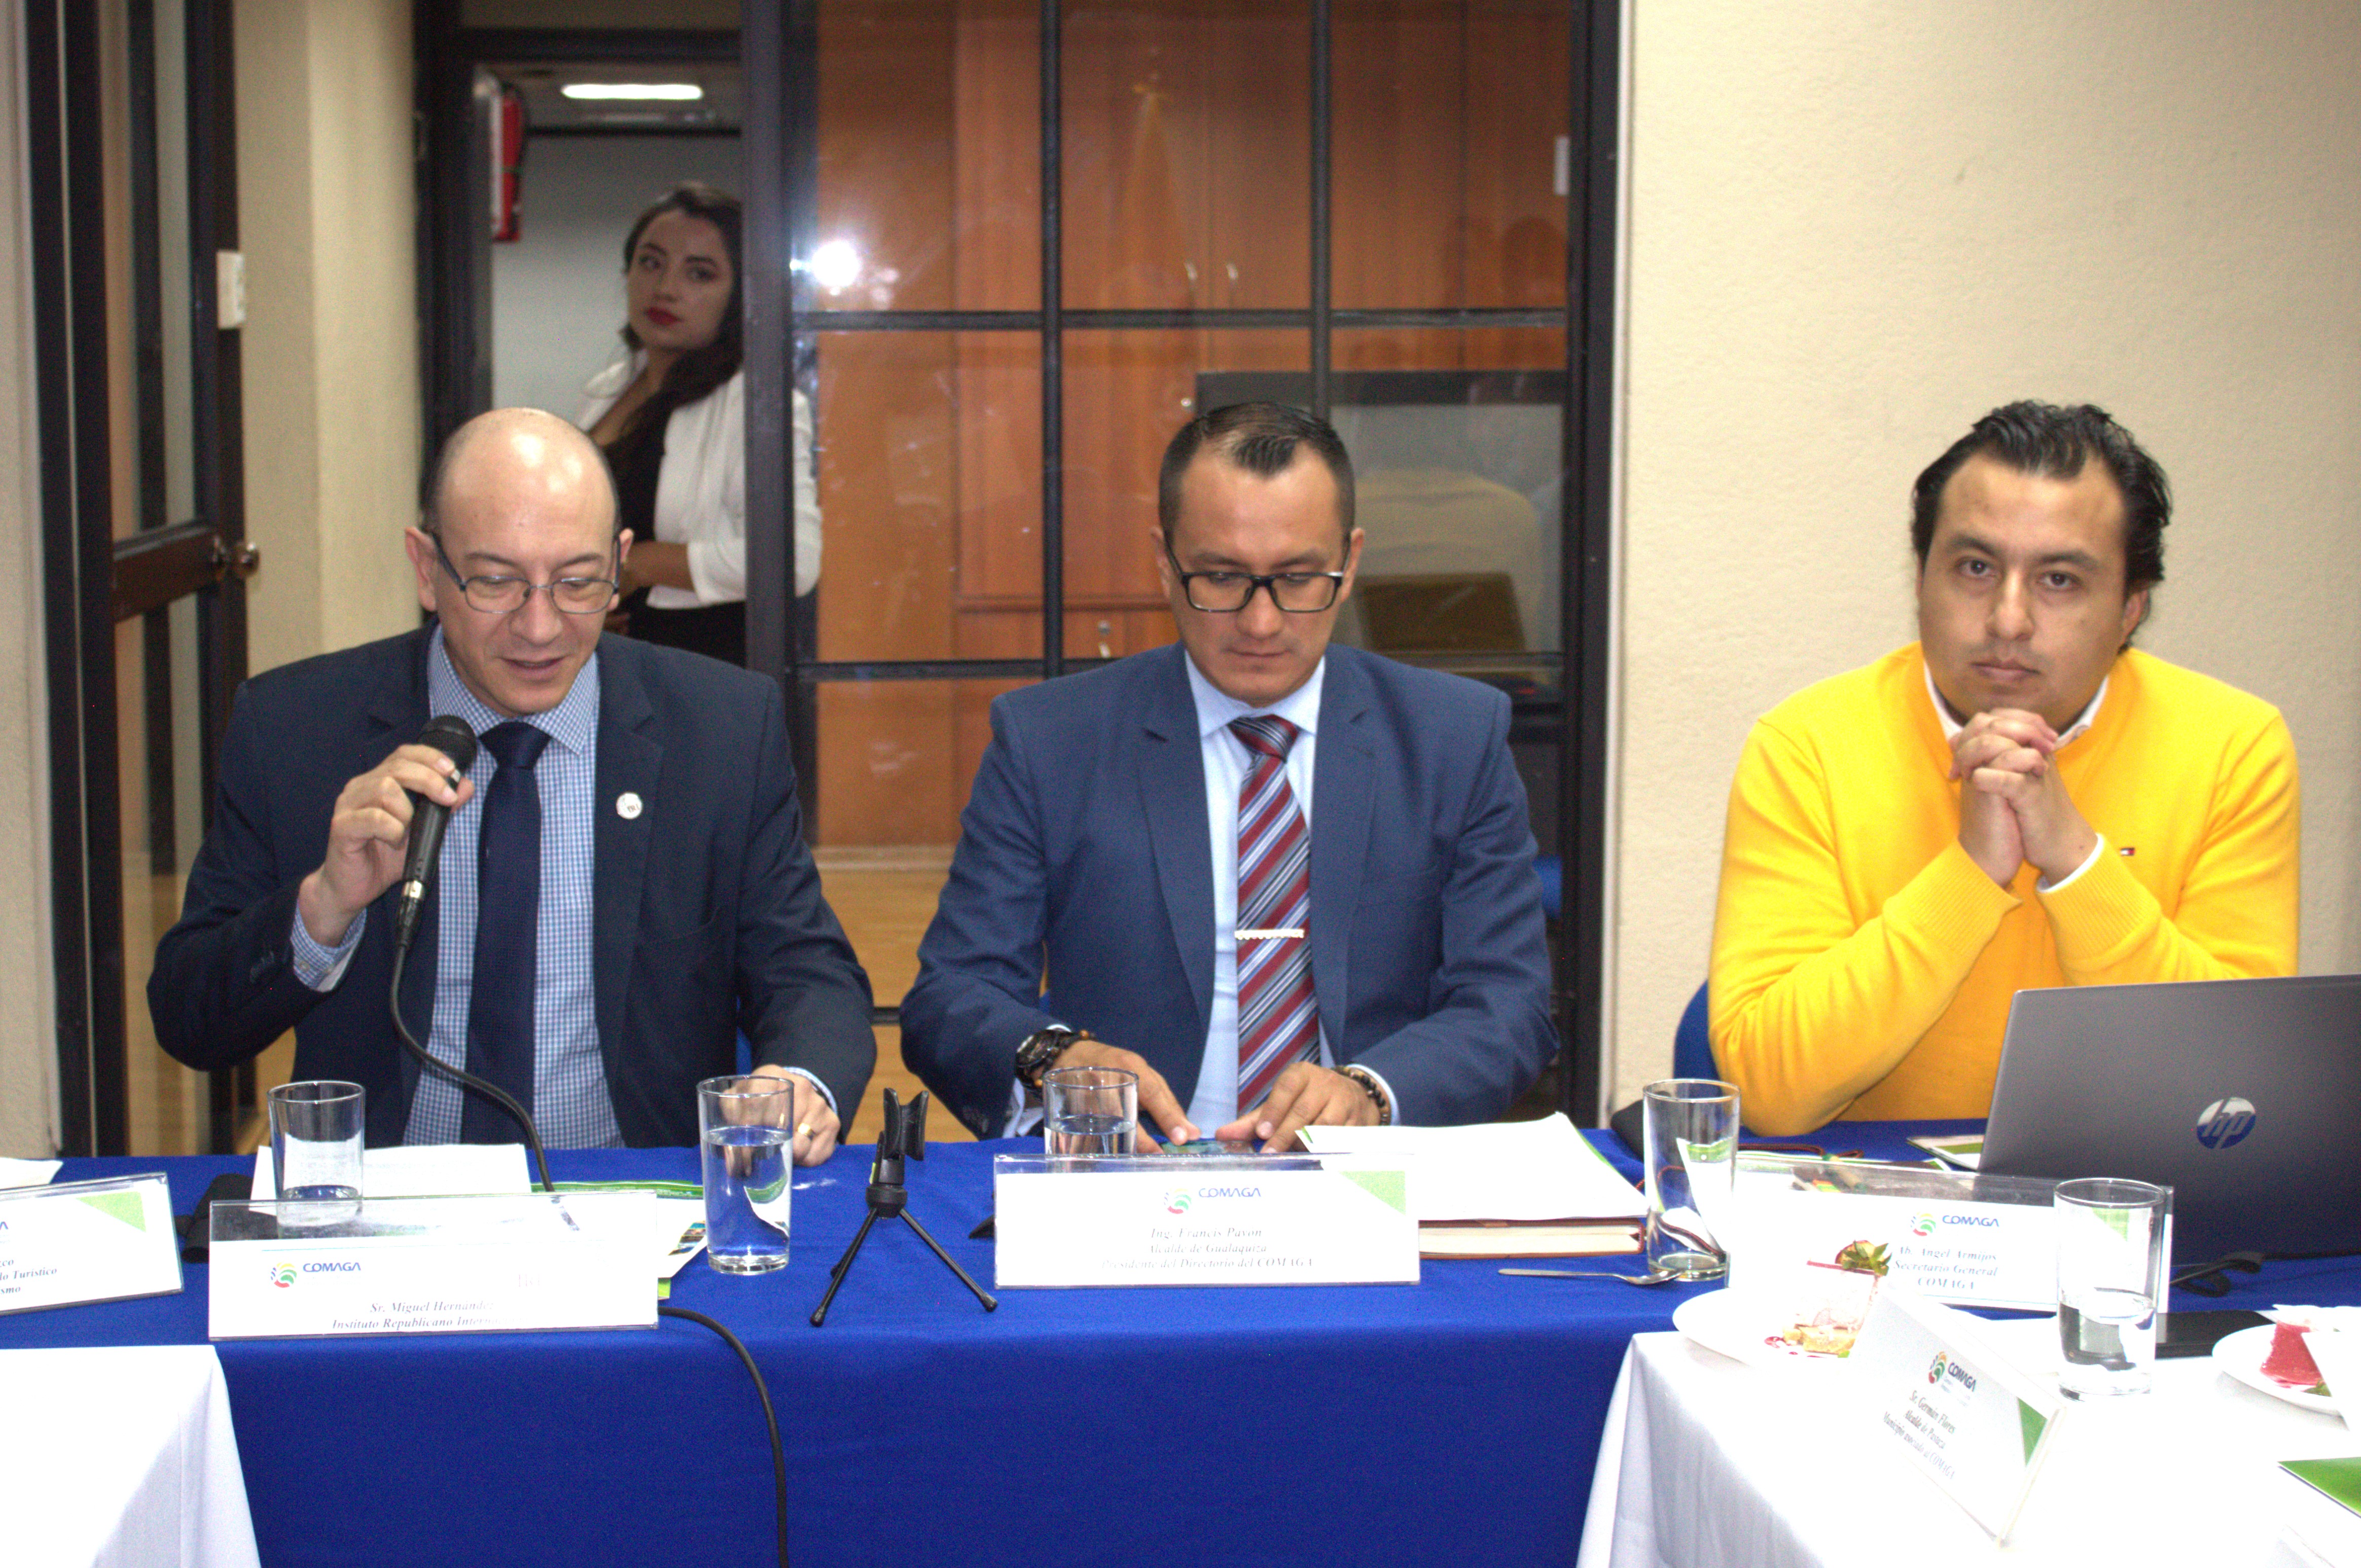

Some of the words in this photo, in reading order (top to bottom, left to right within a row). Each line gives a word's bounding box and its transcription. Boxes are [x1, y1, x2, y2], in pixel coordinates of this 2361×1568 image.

[1198, 1188, 1262, 1198] COMAGA
[1942, 1215, 1999, 1227] COMAGA
[1151, 1228, 1172, 1241] Ing.
[1179, 1227, 1222, 1237] Francis
[1150, 1244, 1185, 1253] Alcalde
[1190, 1244, 1202, 1253] de
[1206, 1244, 1267, 1255] Gualaquiza
[1957, 1250, 1997, 1262] Armijos
[302, 1262, 362, 1272] COMAGA
[1102, 1259, 1157, 1268] Presidente
[1161, 1259, 1176, 1268] del
[1180, 1258, 1234, 1268] Directorio
[1237, 1258, 1254, 1267] del
[1257, 1257, 1312, 1267] COMAGA
[1893, 1260, 1950, 1272] Secretario
[1953, 1264, 1998, 1277] General
[1917, 1277, 1974, 1290] COMAGA
[369, 1303, 386, 1313] Sr.
[392, 1301, 430, 1314] Miguel
[332, 1319, 379, 1329] Instituto
[383, 1318, 453, 1331] Republicano
[1948, 1362, 1977, 1392] COMAGA
[1938, 1413, 1956, 1435] Flores
[1883, 1411, 1905, 1437] Municipio
[1929, 1452, 1955, 1480] COMAGA
